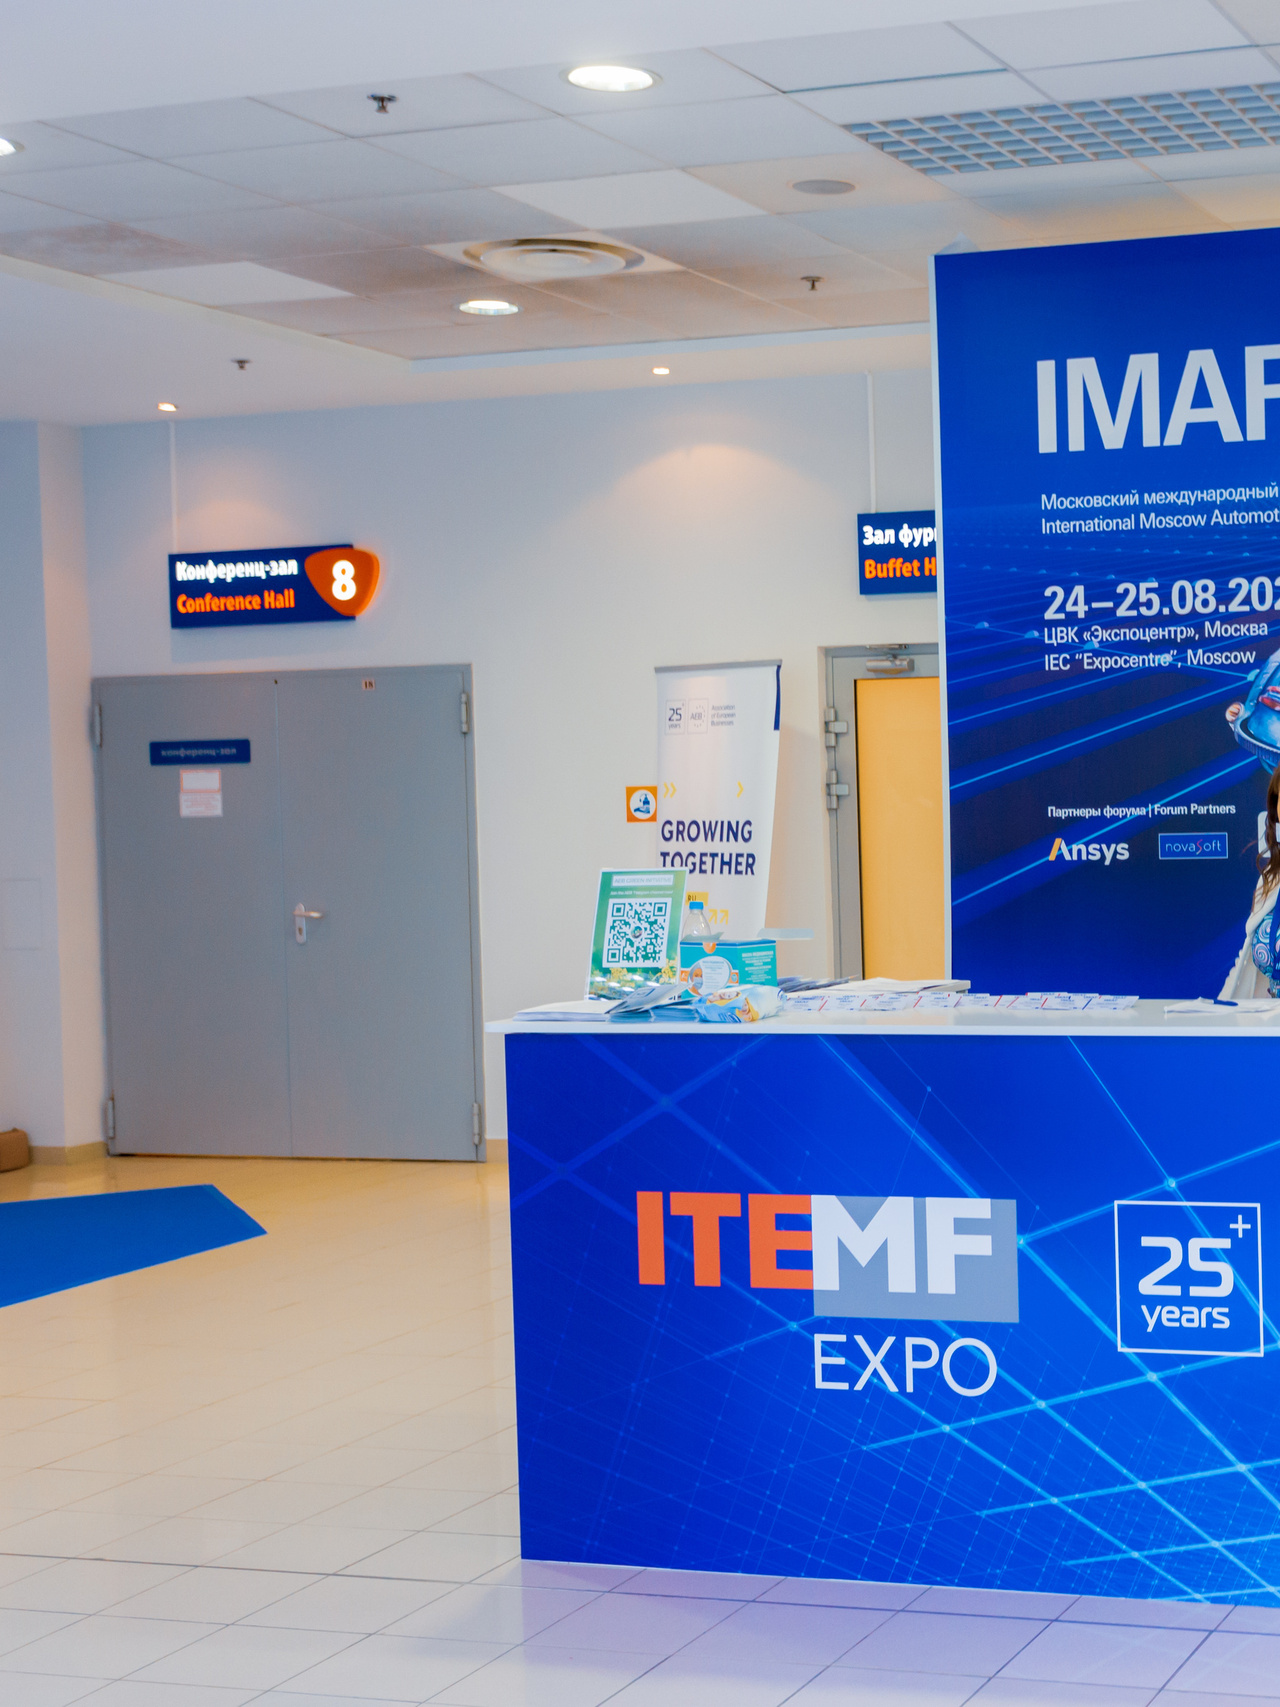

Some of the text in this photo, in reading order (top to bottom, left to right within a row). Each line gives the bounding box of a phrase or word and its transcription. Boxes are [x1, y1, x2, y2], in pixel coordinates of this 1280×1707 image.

[1041, 489, 1139, 510] Московский
[1143, 481, 1279, 507] международный
[1041, 513, 1135, 534] International
[1139, 511, 1207, 530] Moscow
[862, 523, 937, 548] Зал фур
[175, 559, 298, 584] Конференц-зал
[331, 559, 357, 601] 8
[864, 557, 921, 579] Buffet
[176, 588, 295, 613] Conference Hall
[1044, 621, 1269, 646] ЦВК «Экспоцентр», Москва
[1044, 653, 1071, 671] IEC
[1187, 649, 1257, 667] Moscow
[1048, 806, 1101, 819] Партнеры
[1103, 805, 1147, 818] форума
[1154, 803, 1236, 815] Forum Partners
[661, 820, 753, 843] GROWING
[660, 851, 756, 876] TOGETHER
[1048, 838, 1130, 865] Ansys
[636, 1191, 992, 1295] ITEMF
[1140, 1304, 1231, 1332] years
[813, 1333, 998, 1397] EXPO
